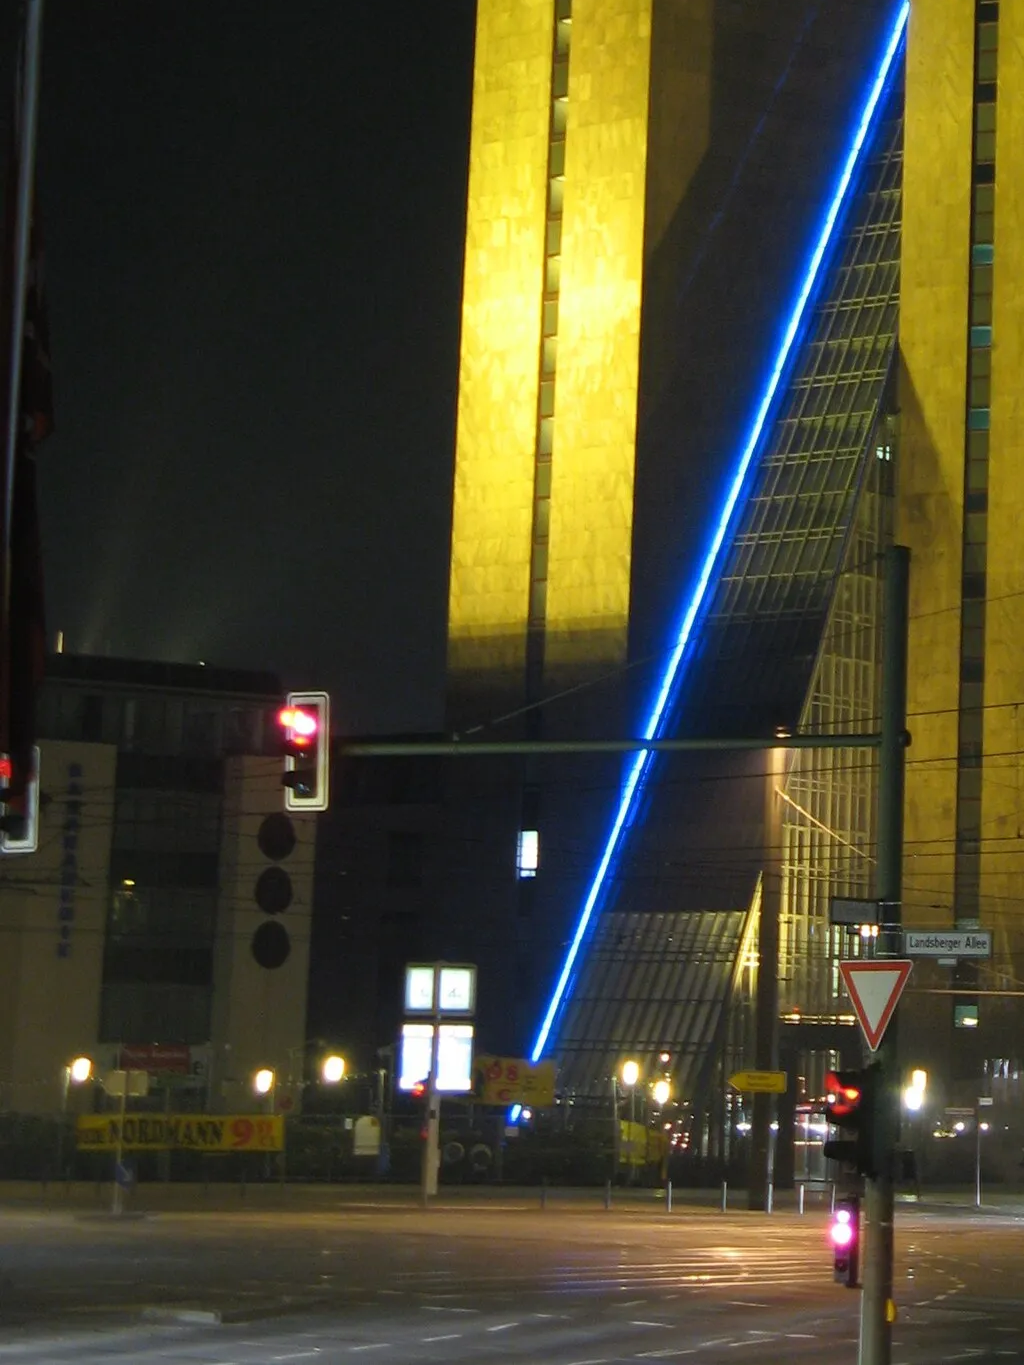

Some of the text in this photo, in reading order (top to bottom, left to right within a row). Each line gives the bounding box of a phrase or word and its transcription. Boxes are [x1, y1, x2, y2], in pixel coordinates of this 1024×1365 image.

[909, 936, 987, 951] Landsberger Allee
[108, 1118, 224, 1146] NORDMANN
